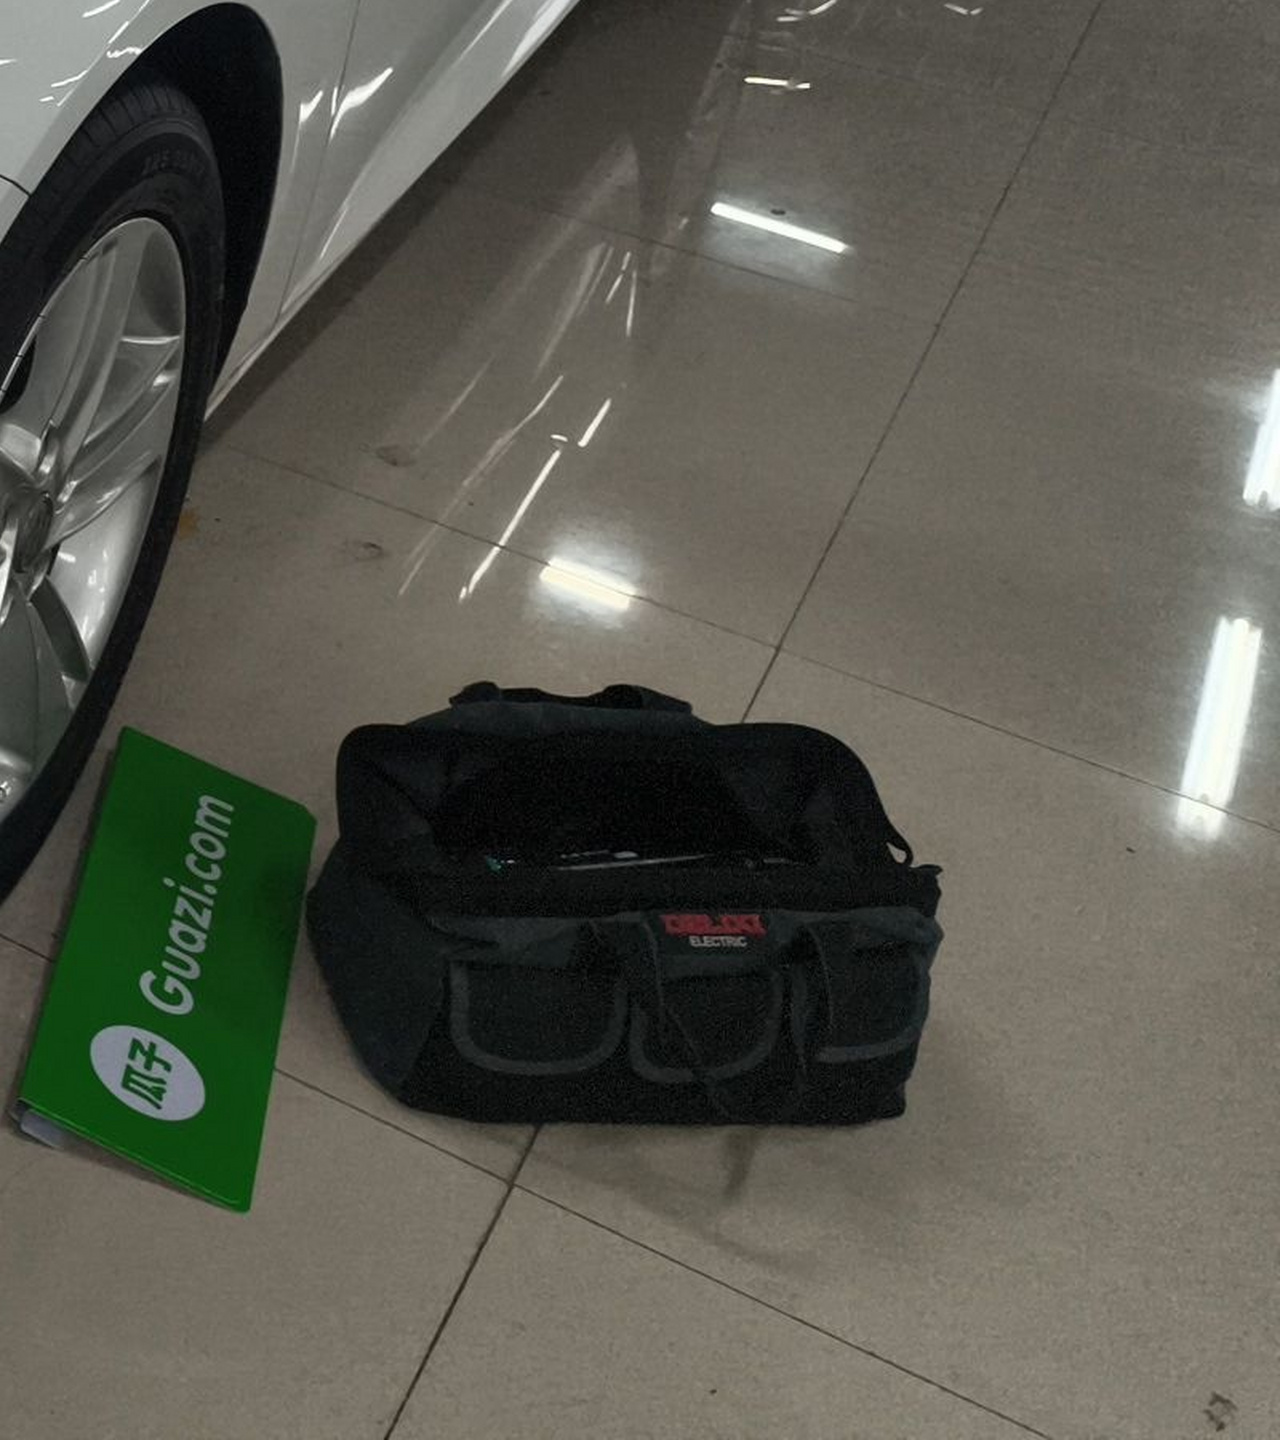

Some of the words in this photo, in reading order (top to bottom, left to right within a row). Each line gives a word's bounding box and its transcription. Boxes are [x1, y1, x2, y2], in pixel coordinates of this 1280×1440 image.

[139, 794, 235, 1016] Guazi.com
[688, 935, 748, 948] ELECTRIC
[120, 1037, 173, 1111] 瓜子
